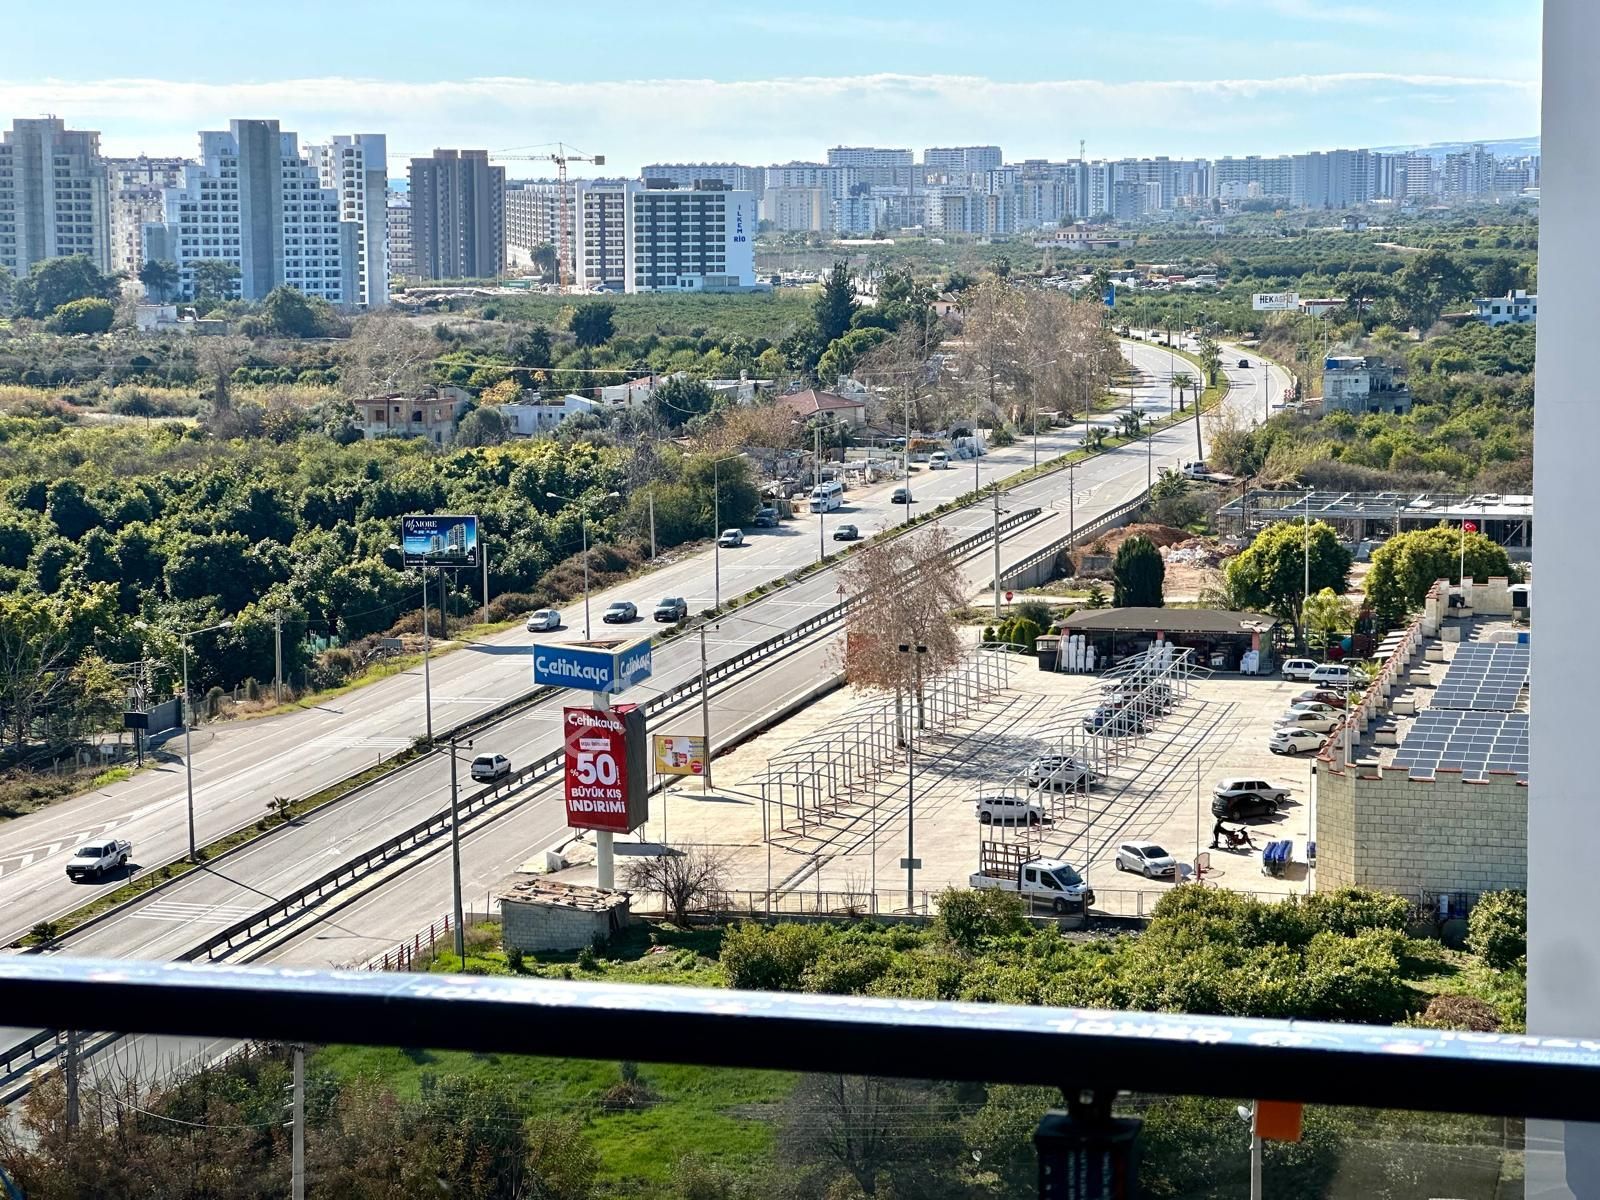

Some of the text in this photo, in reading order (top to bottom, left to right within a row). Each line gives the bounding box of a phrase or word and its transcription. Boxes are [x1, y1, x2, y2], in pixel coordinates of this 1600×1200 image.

[536, 656, 608, 684] Çetinkaya
[571, 785, 622, 800] BÜYÜK KIŞ
